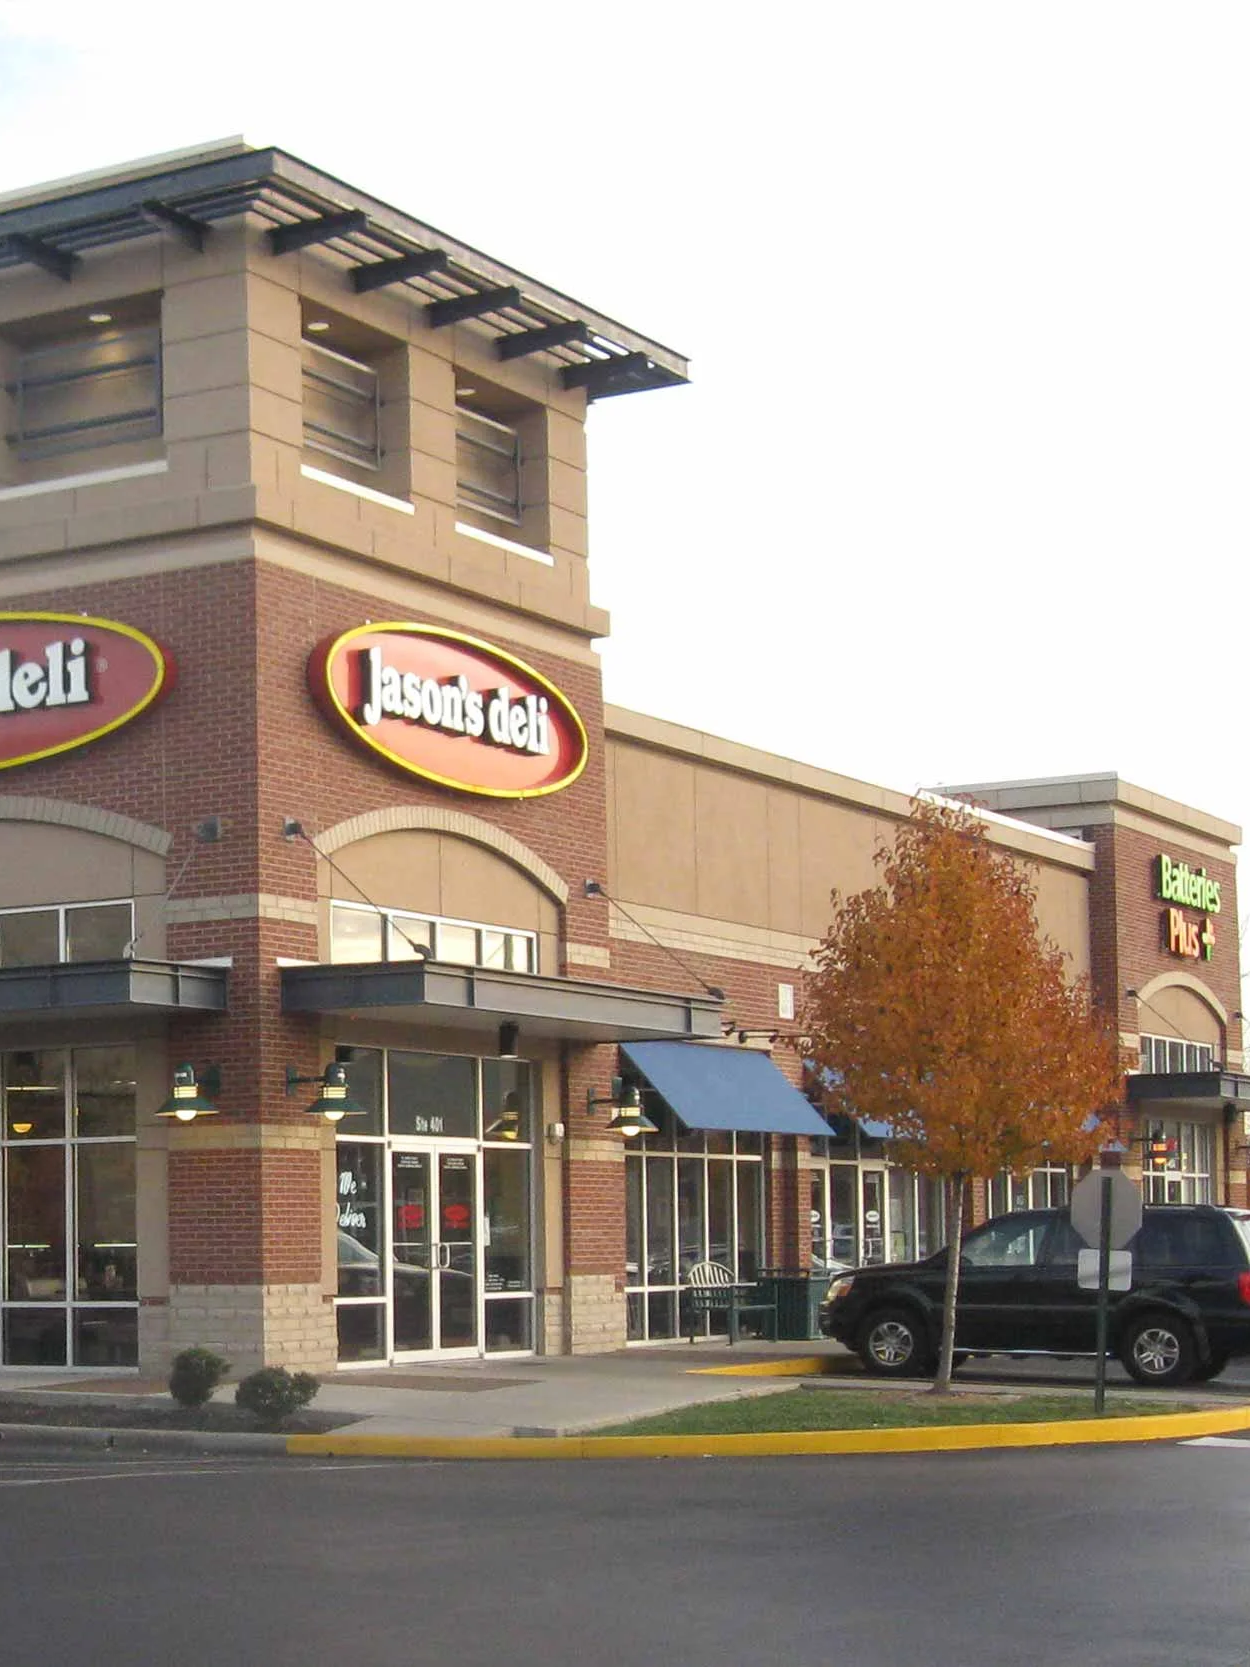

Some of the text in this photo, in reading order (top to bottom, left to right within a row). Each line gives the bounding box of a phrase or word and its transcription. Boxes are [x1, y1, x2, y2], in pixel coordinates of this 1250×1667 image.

[364, 646, 551, 755] Jason's deli
[1161, 853, 1221, 913] Batteries
[1170, 908, 1199, 957] Plus
